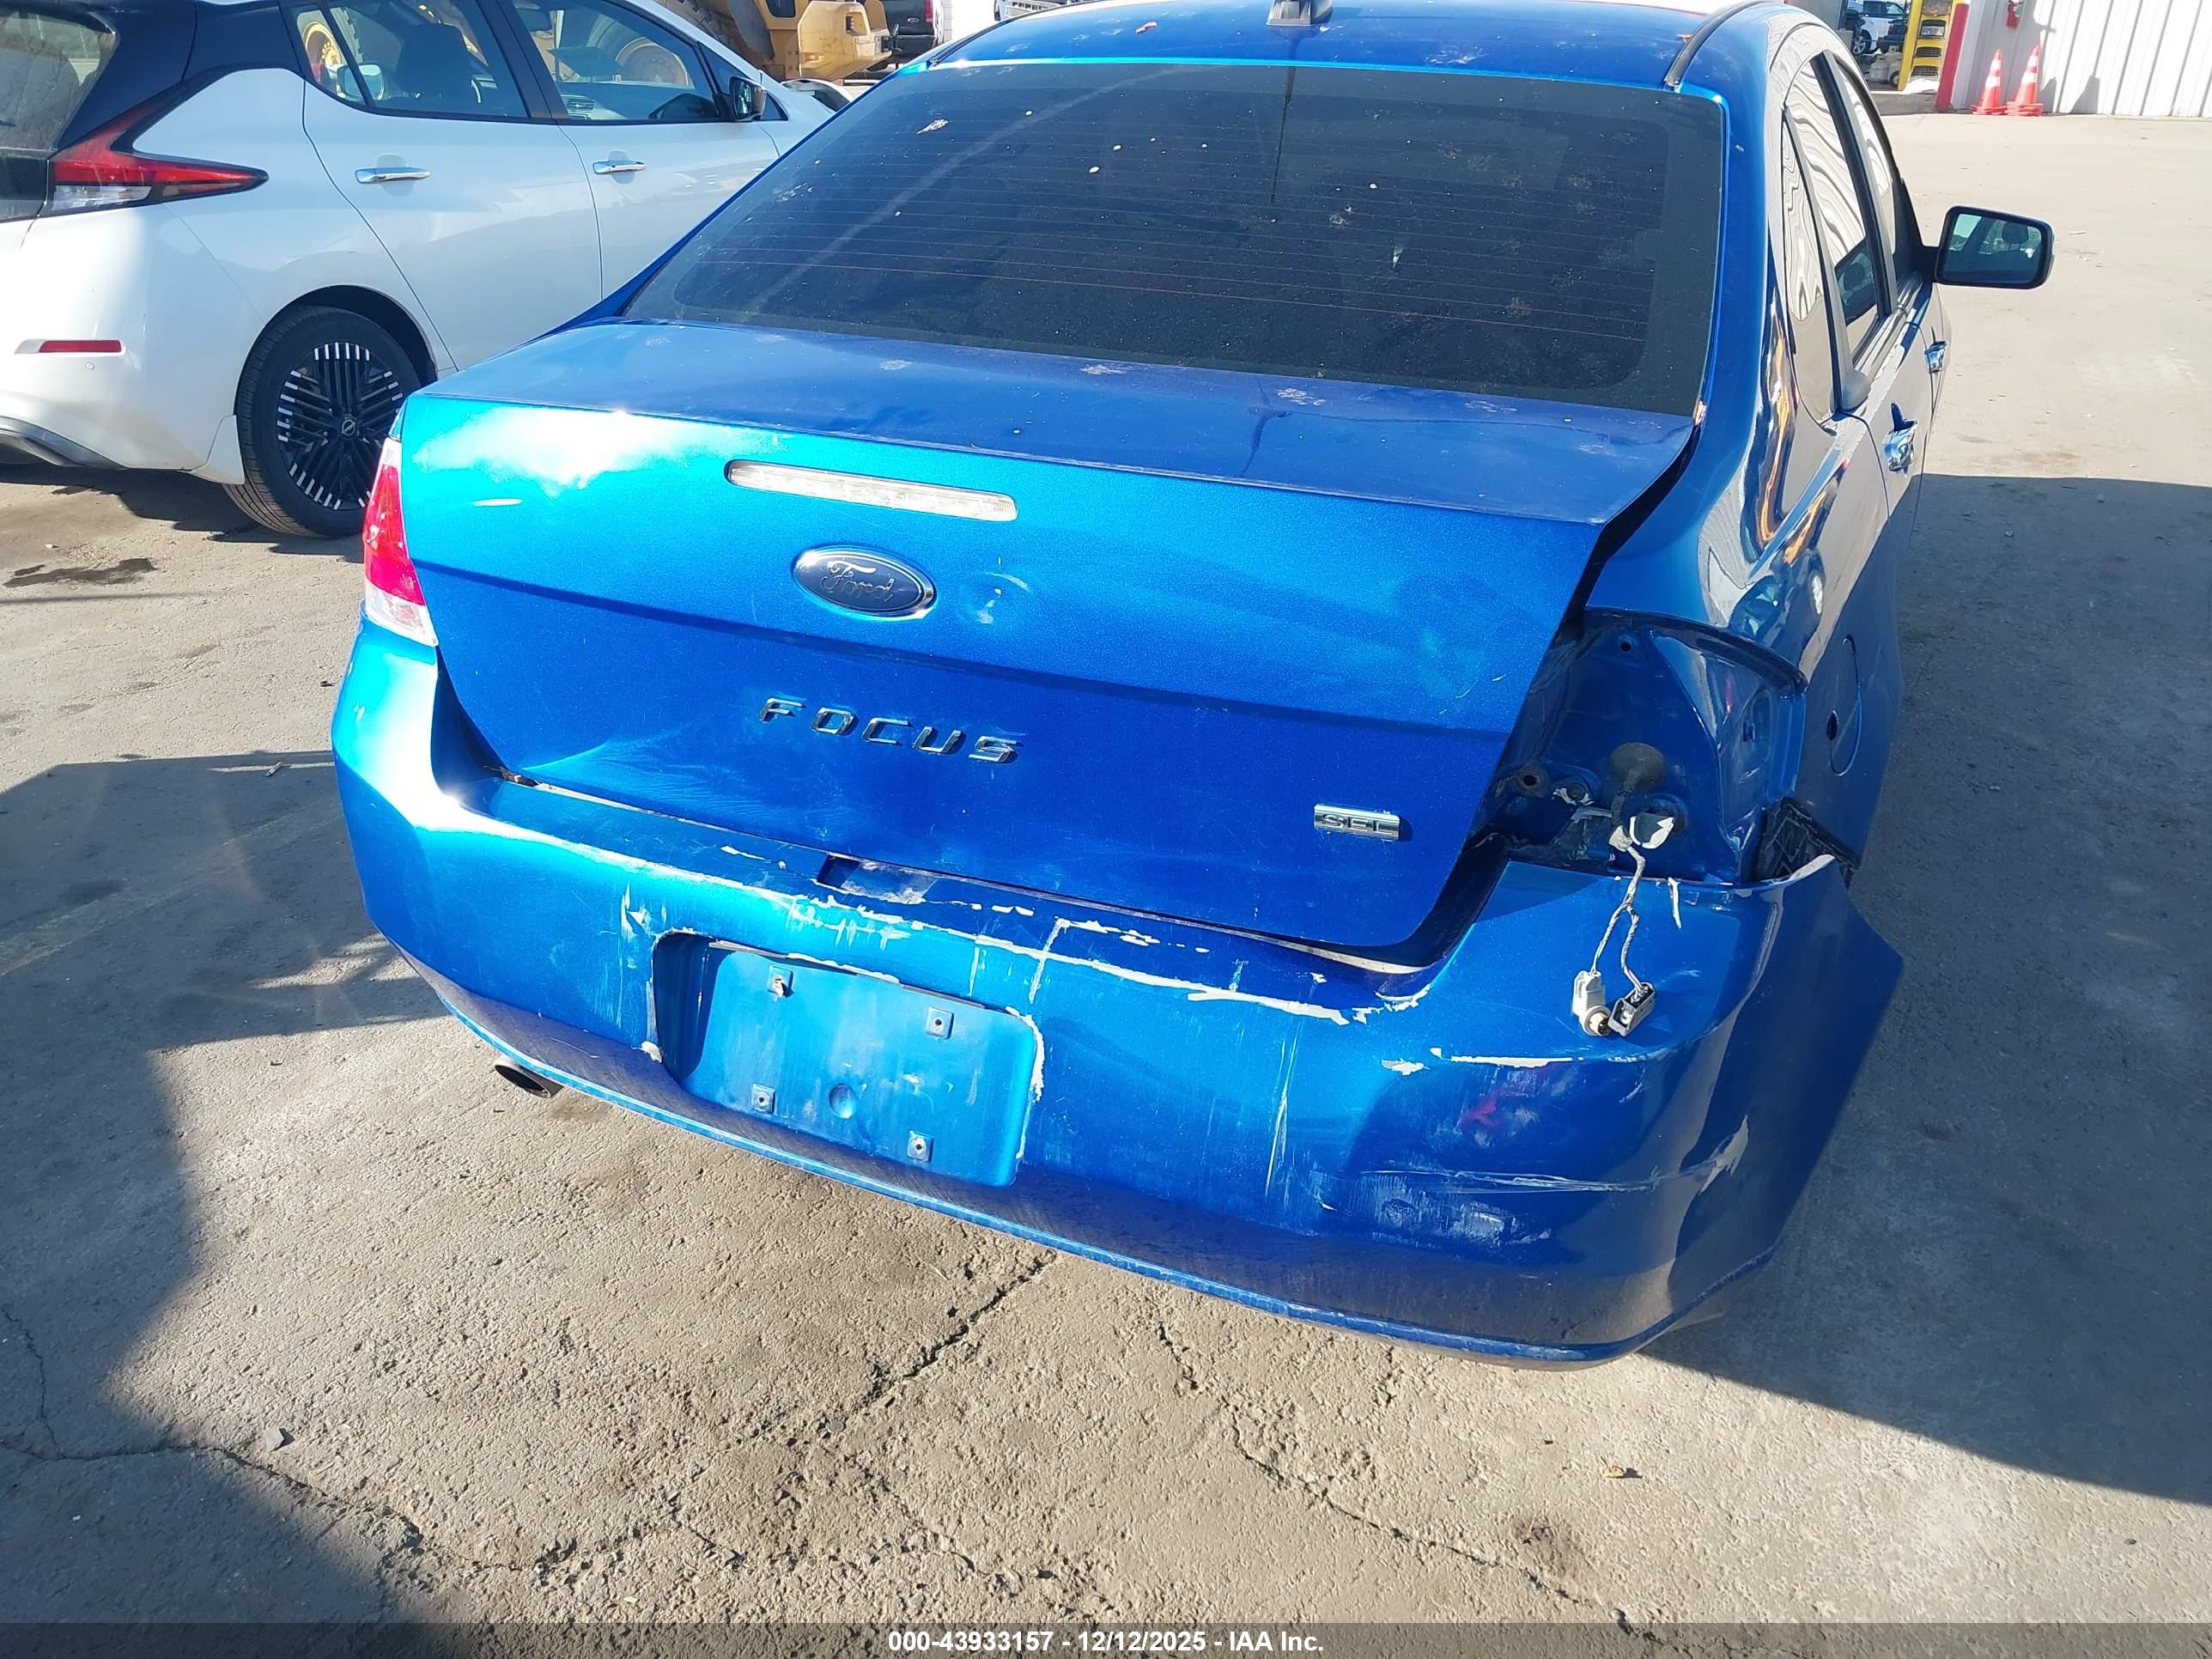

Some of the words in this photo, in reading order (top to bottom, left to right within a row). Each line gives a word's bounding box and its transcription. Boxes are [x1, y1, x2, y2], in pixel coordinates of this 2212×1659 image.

[822, 560, 895, 602] Ford
[759, 696, 1021, 763] FOCUS
[1322, 813, 1393, 836] SEL
